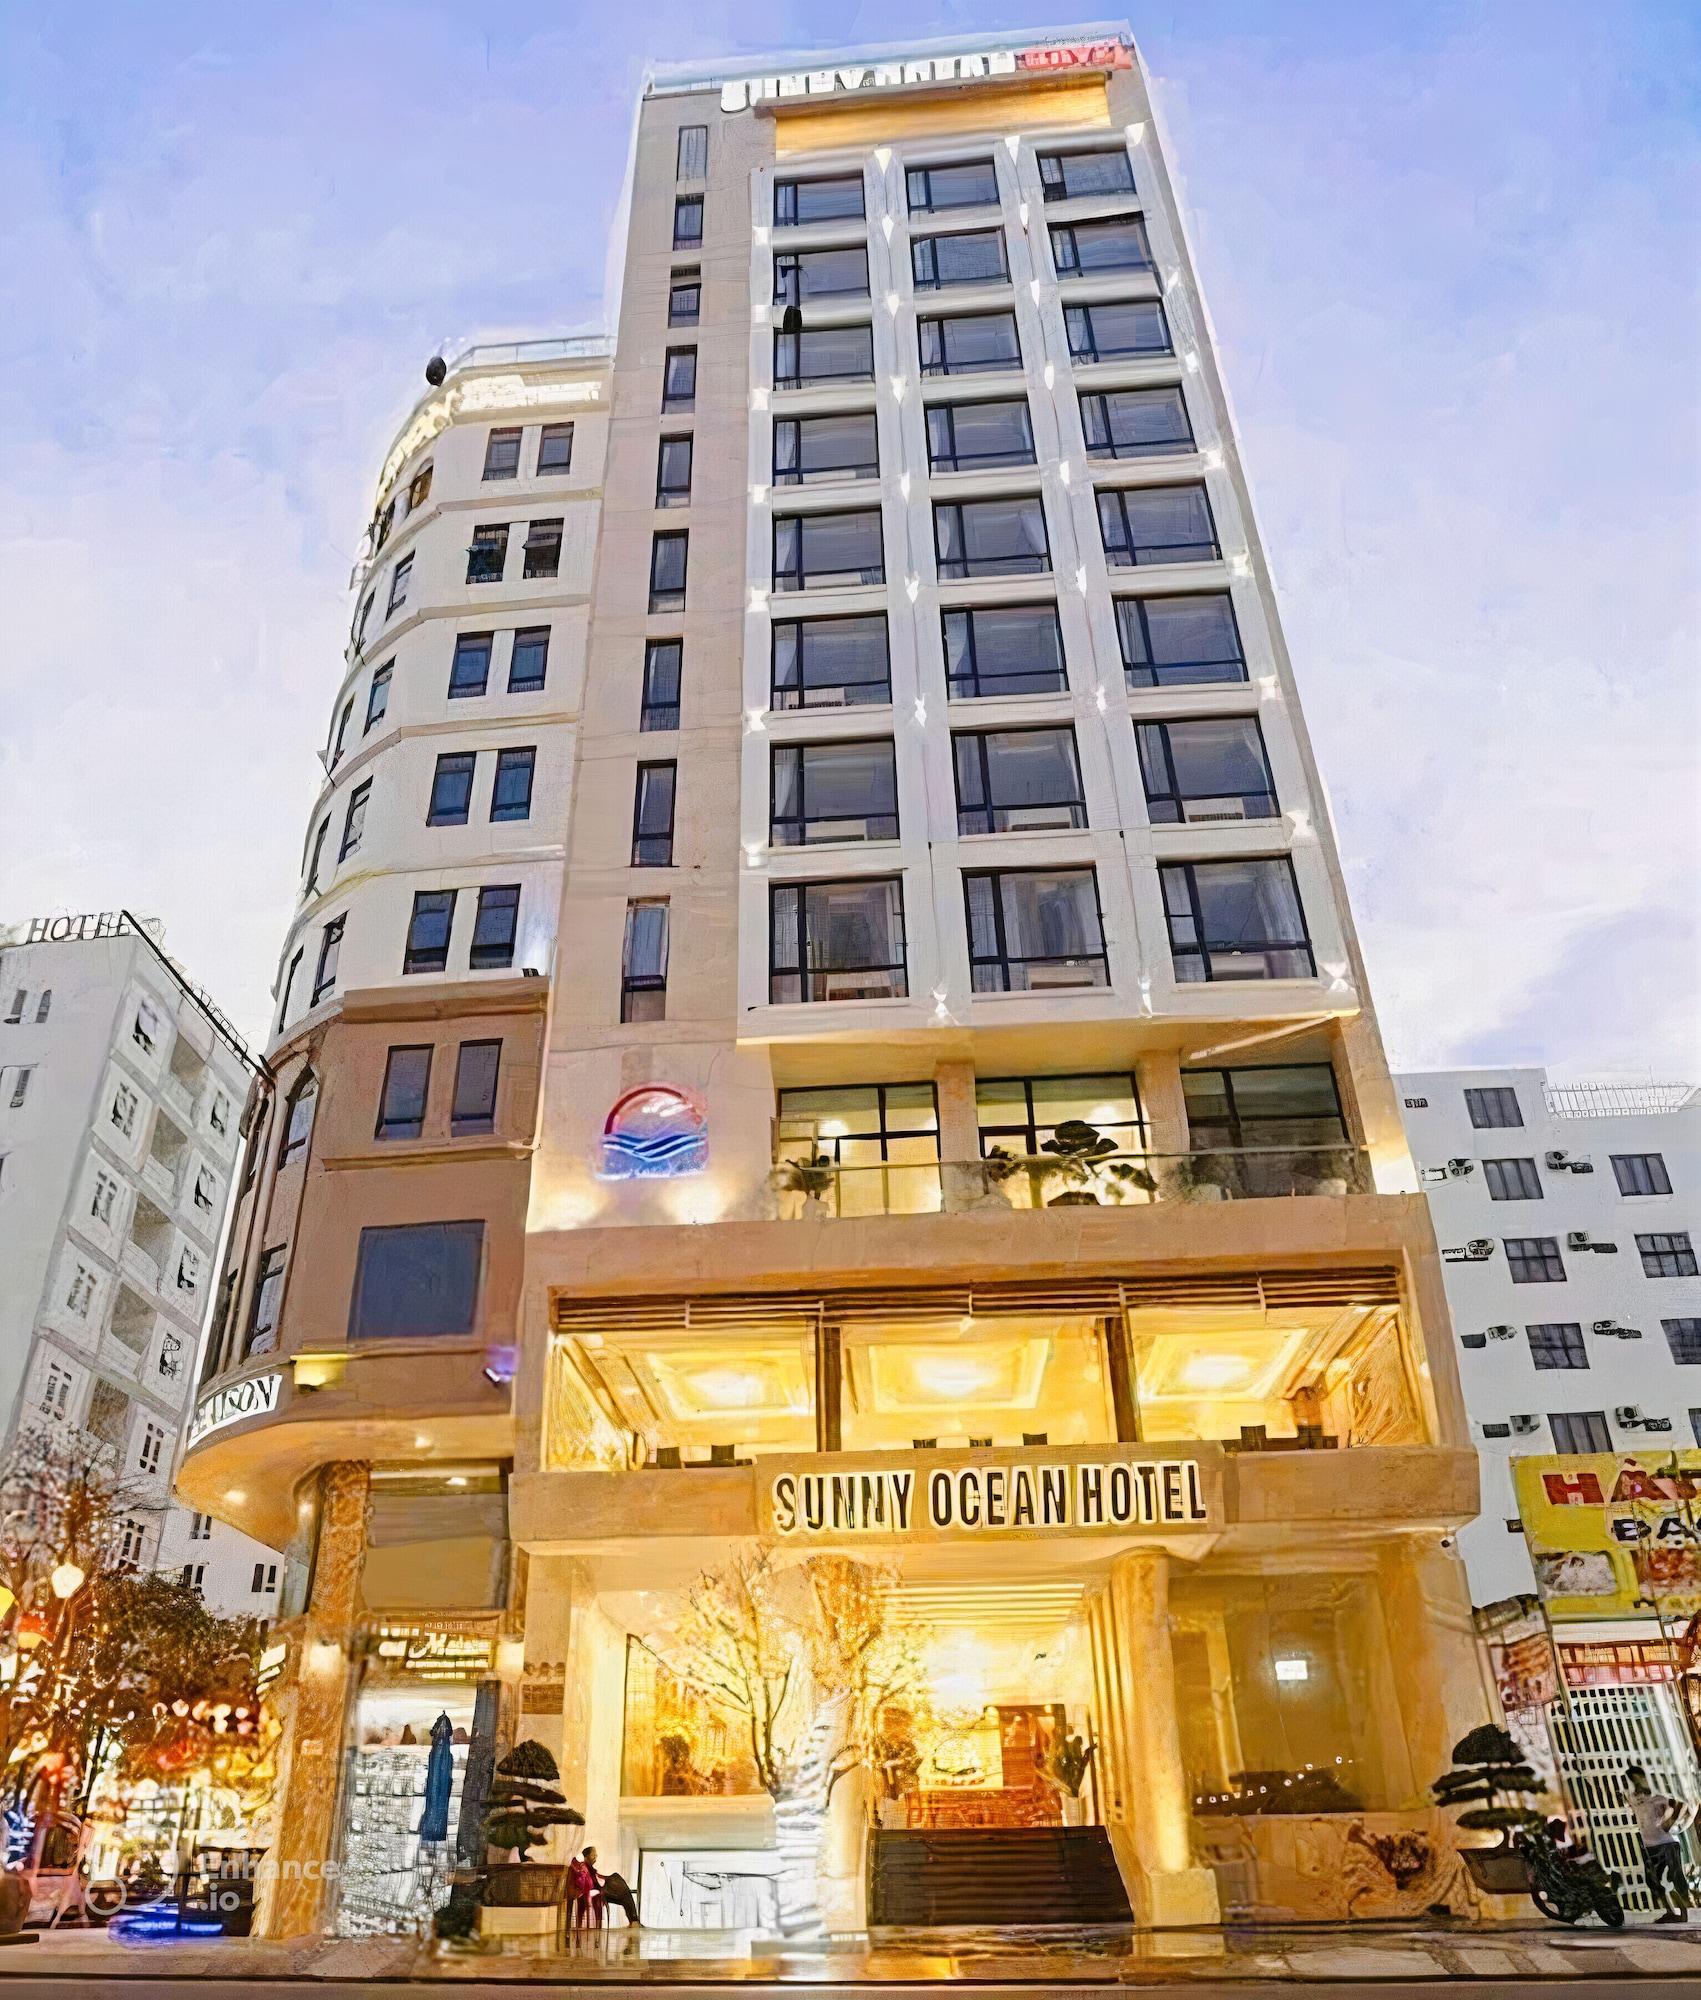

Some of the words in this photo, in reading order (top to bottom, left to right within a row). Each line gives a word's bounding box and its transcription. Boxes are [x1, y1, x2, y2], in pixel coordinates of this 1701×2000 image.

[772, 1471, 914, 1533] SUNNY
[929, 1466, 1069, 1528] OCEAN
[1077, 1461, 1208, 1526] HOTEL
